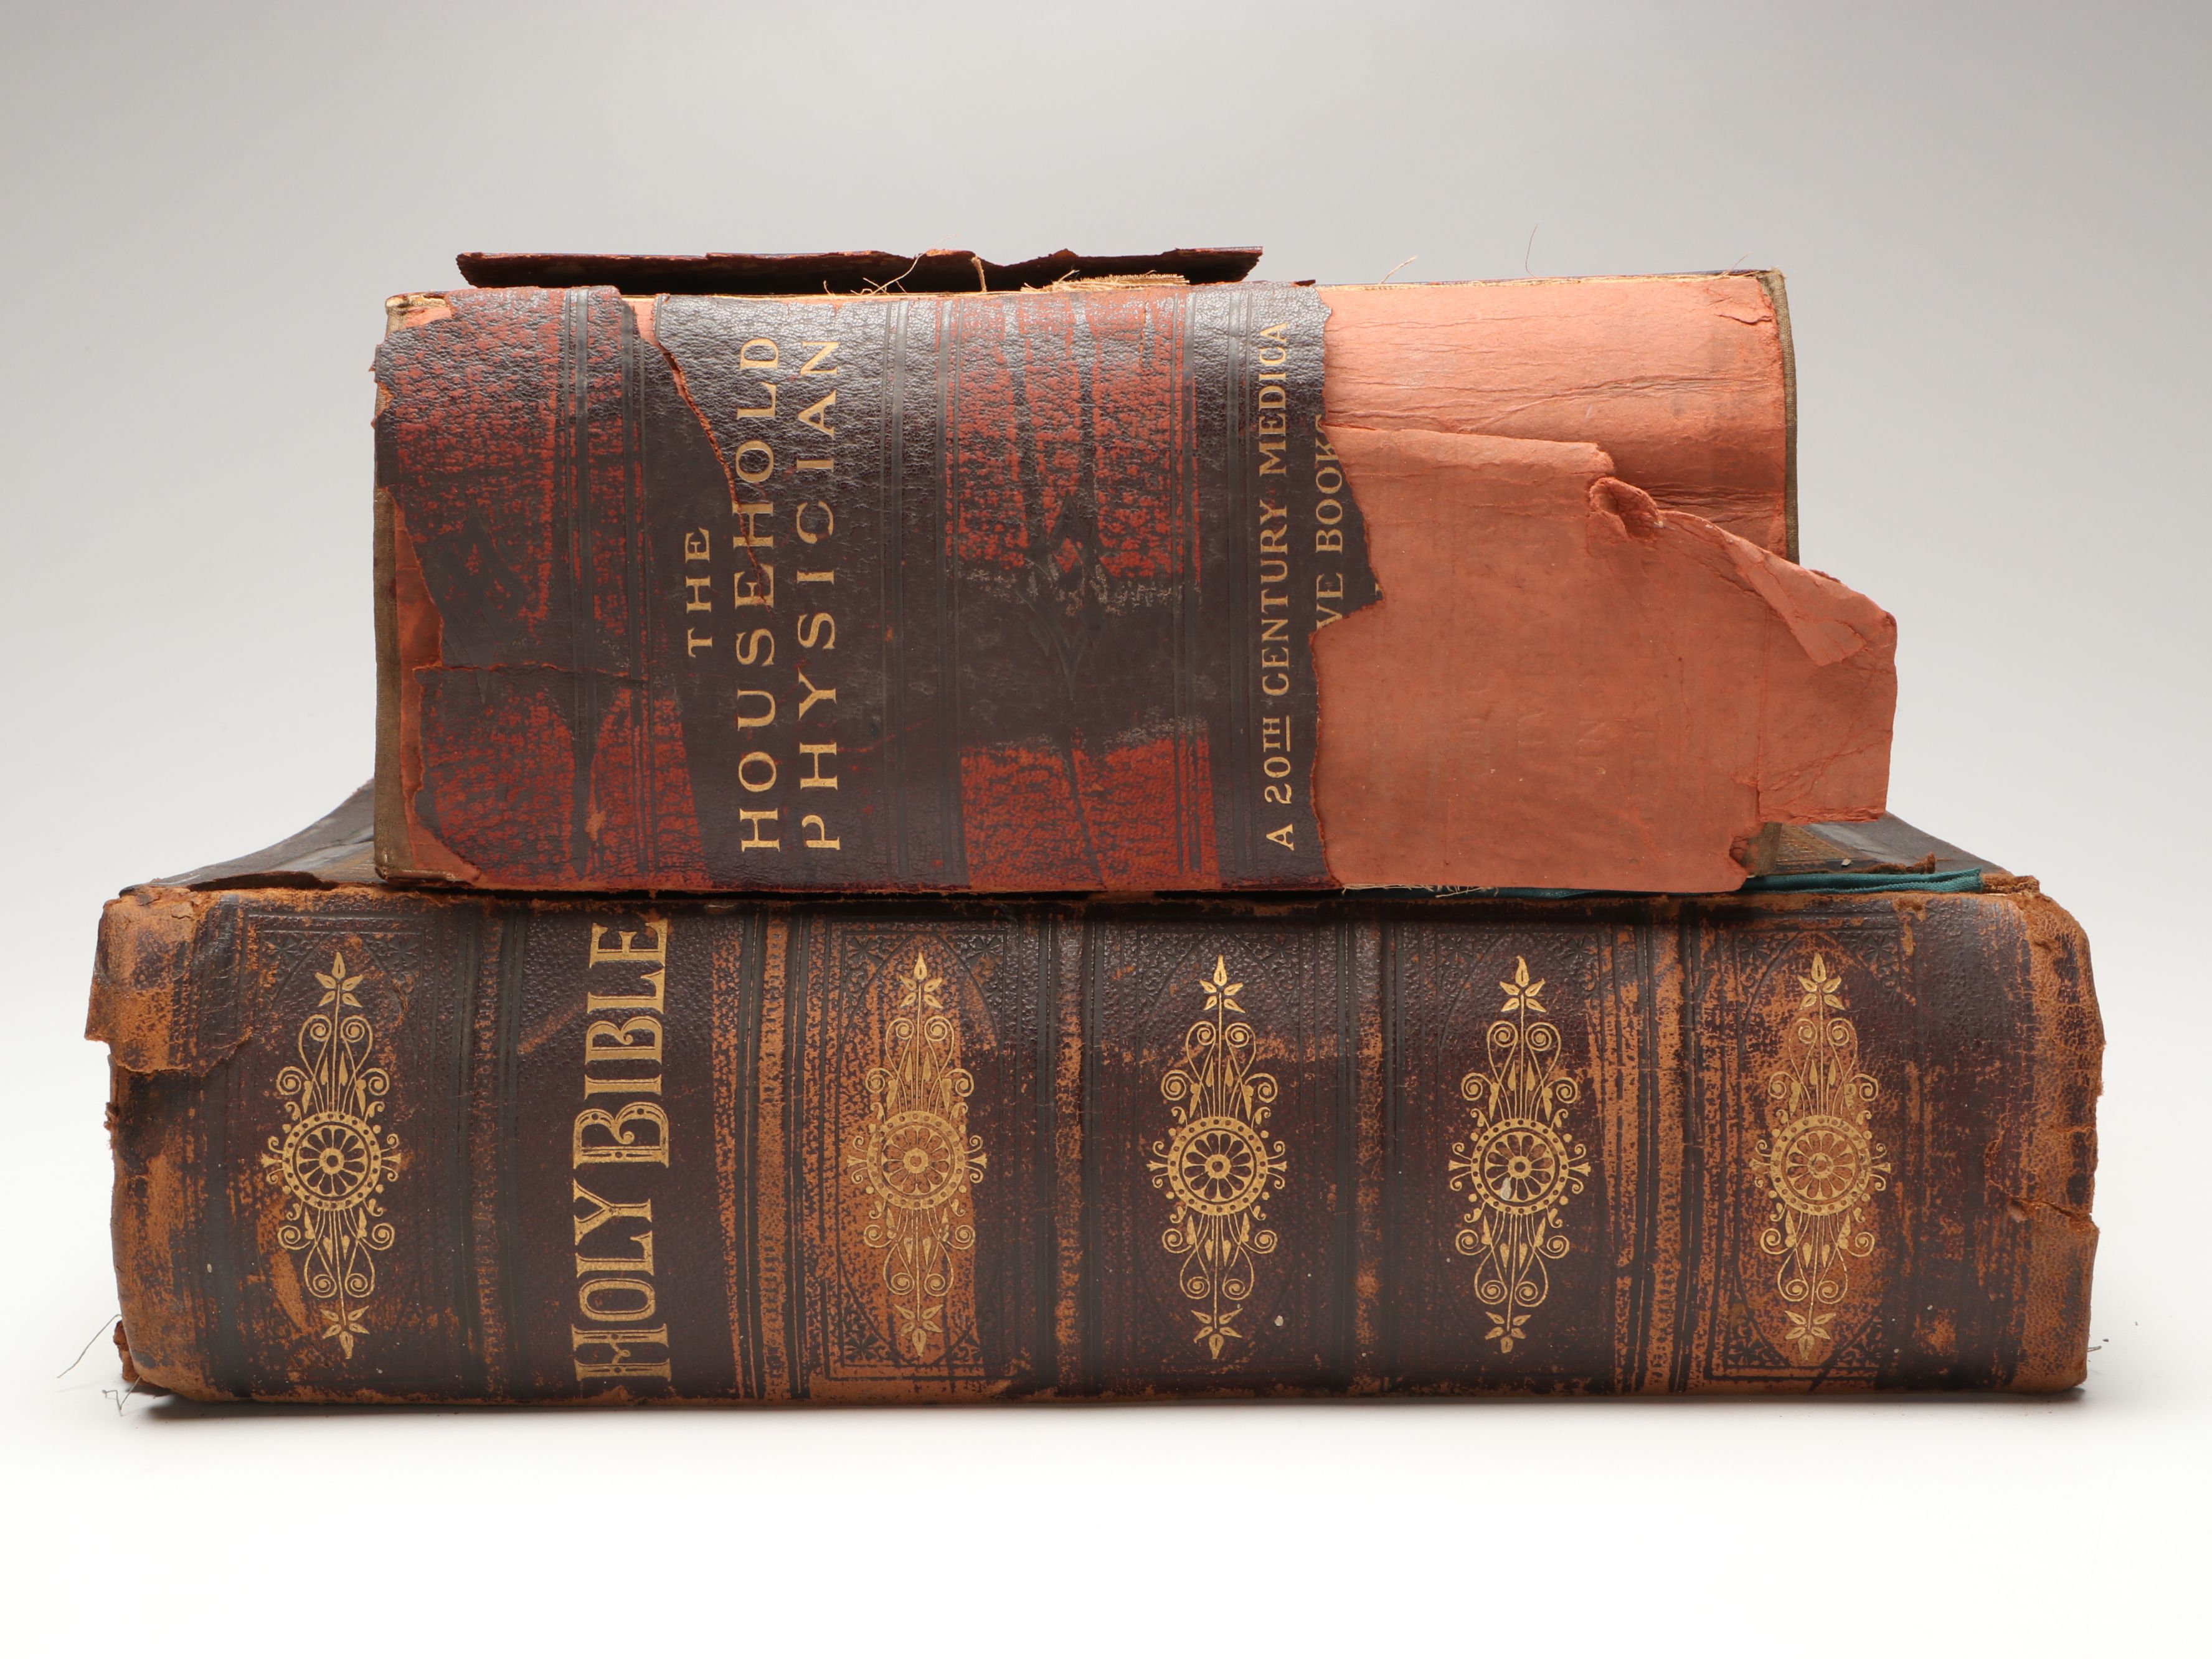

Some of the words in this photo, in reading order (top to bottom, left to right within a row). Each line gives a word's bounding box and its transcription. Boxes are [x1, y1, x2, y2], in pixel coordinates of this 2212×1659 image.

[1259, 321, 1288, 476] MEDICA
[685, 527, 712, 658] THE
[732, 338, 780, 853] HOUSEHOLD
[796, 341, 841, 851] PHYSICIAN
[1260, 499, 1290, 696] CENTURY
[1262, 716, 1292, 805] 20TH
[1265, 822, 1294, 851] A
[573, 917, 669, 1168] BIBLE
[572, 1177, 672, 1382] HOLY
